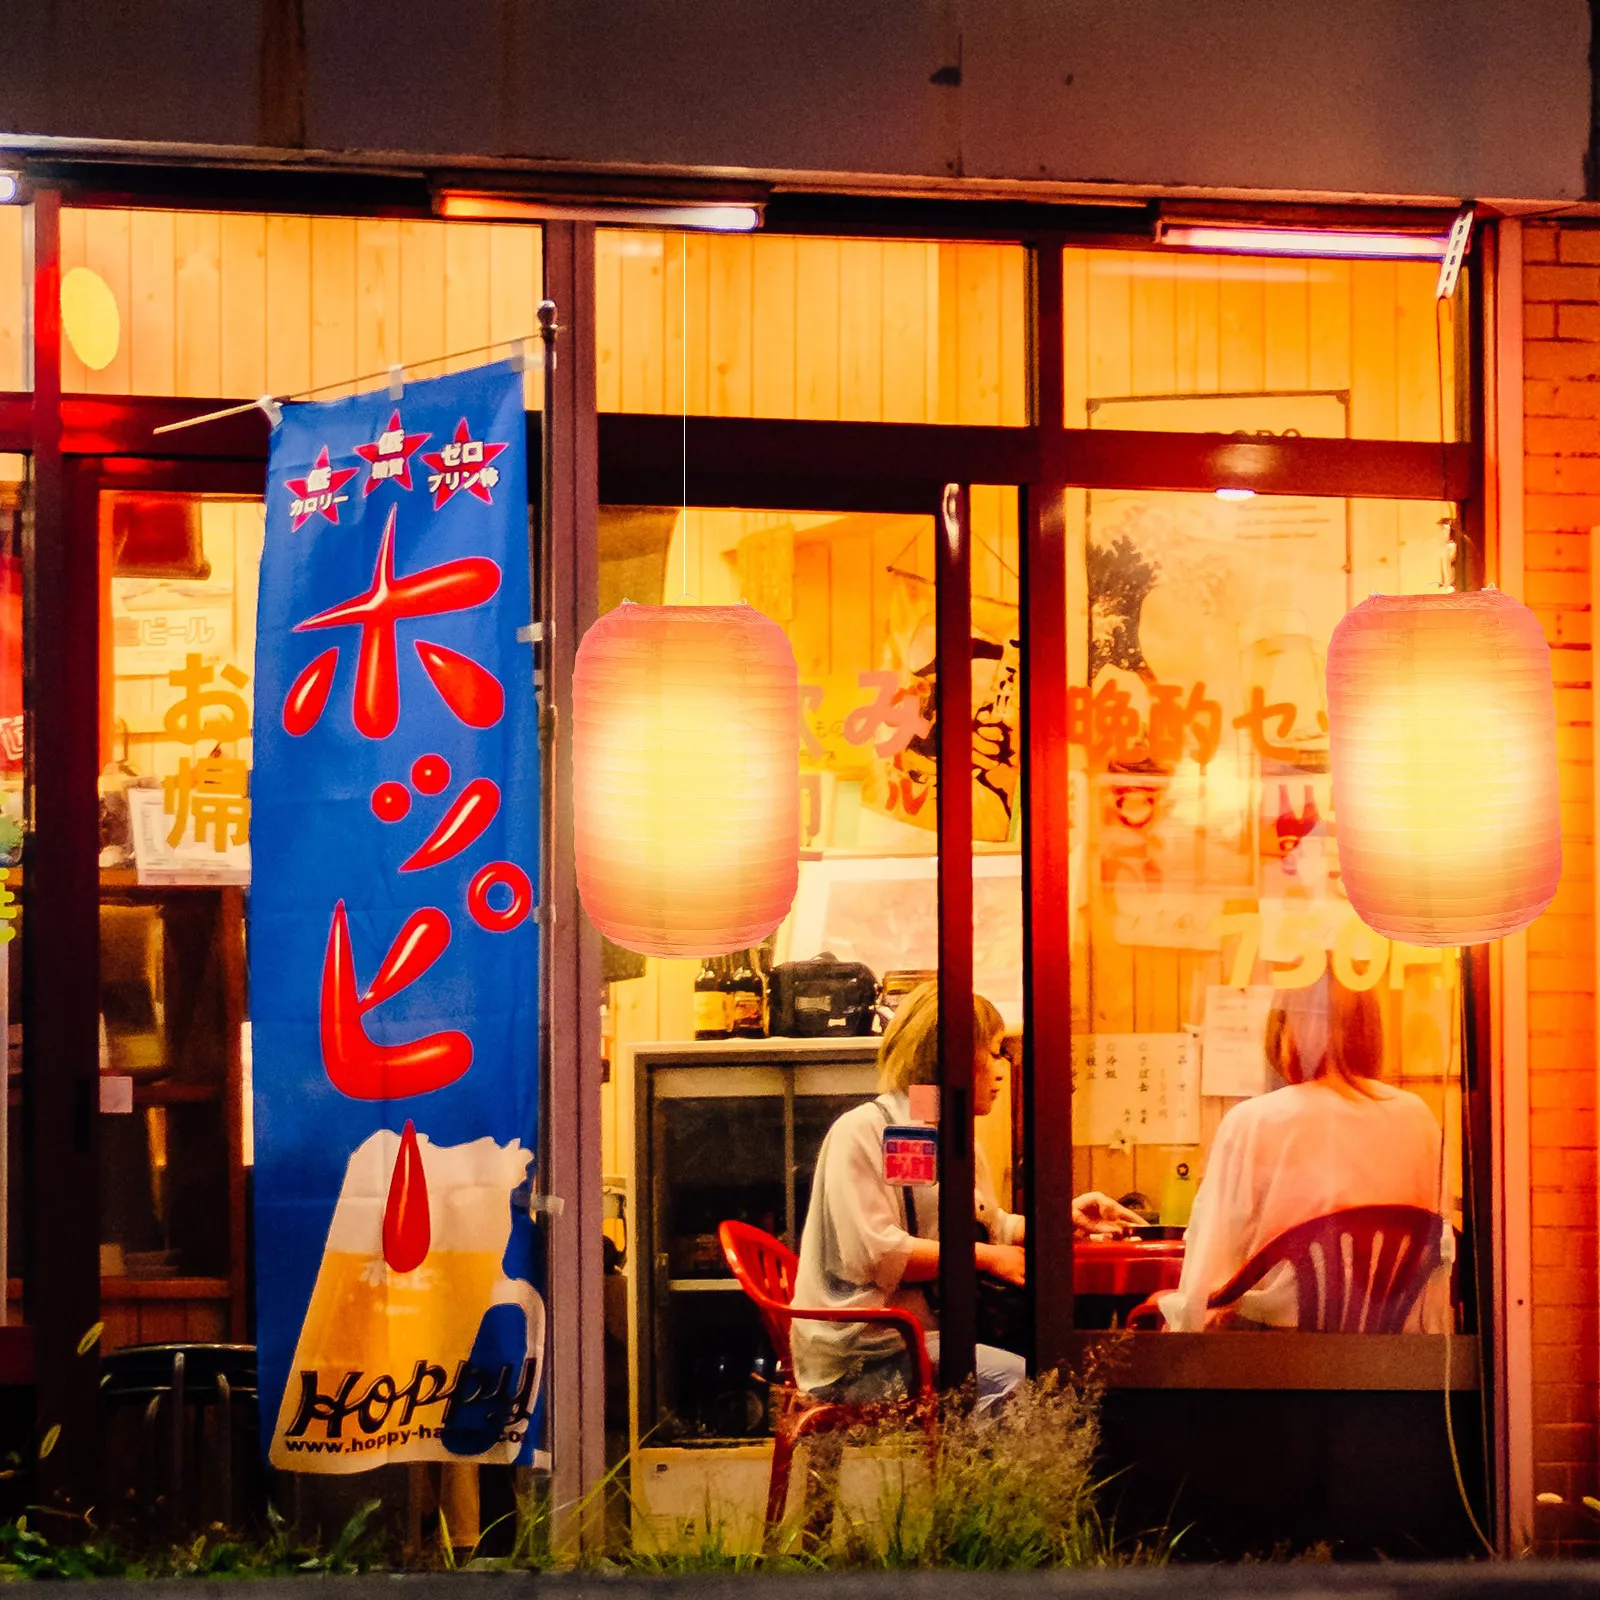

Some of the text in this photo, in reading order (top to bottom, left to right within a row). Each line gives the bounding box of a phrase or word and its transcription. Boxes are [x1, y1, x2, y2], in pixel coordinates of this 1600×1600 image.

[441, 441, 484, 467] ゼロ
[289, 494, 349, 518] カロリー
[285, 1358, 537, 1438] Hoppy
